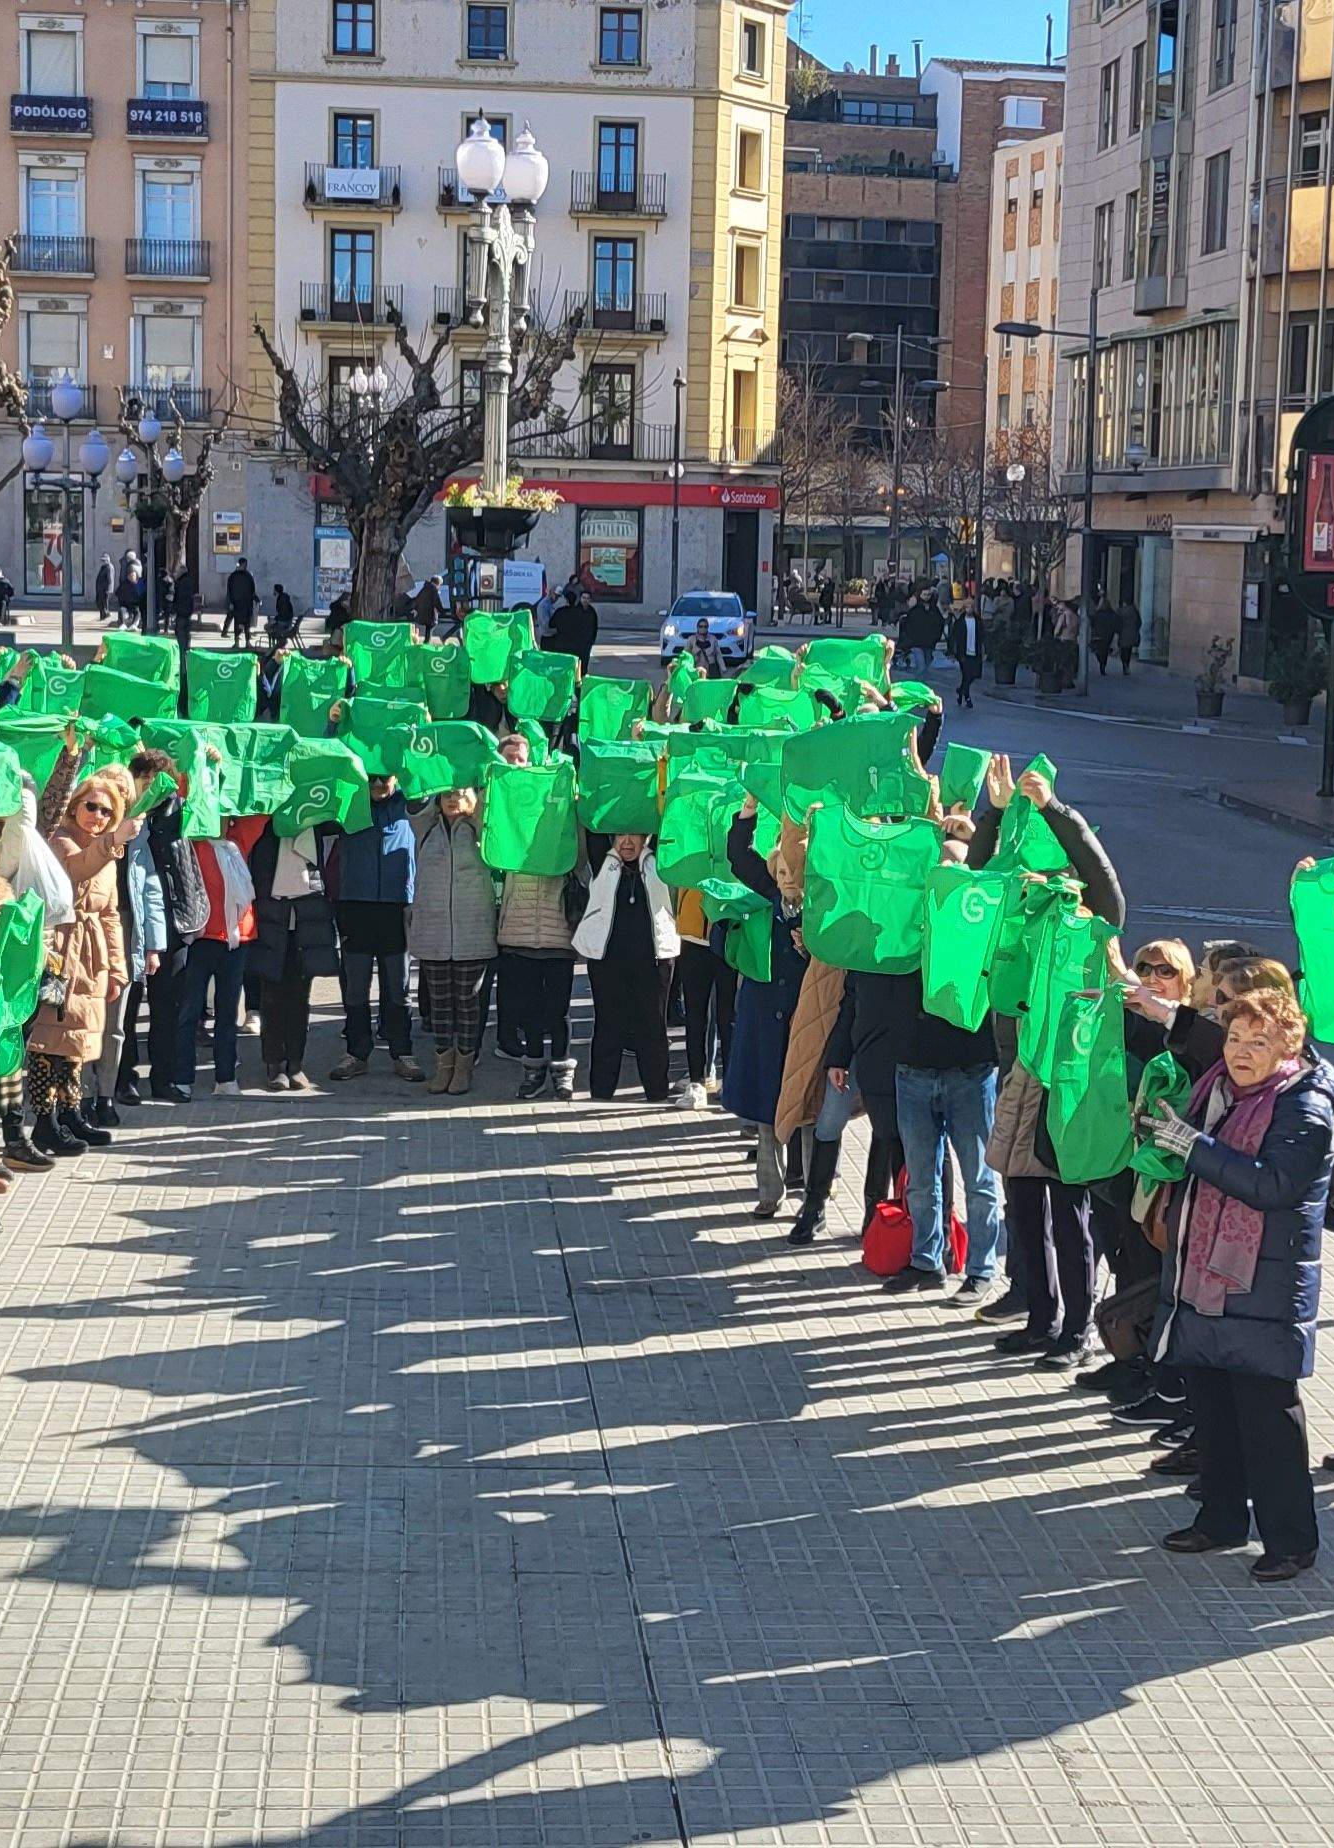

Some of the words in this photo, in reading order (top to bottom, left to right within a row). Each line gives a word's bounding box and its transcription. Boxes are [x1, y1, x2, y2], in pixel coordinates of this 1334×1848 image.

[14, 104, 87, 119] PODÓLOGO
[130, 109, 152, 122] 974
[155, 110, 177, 123] 218
[179, 111, 202, 124] 518
[730, 491, 767, 504] Santander
